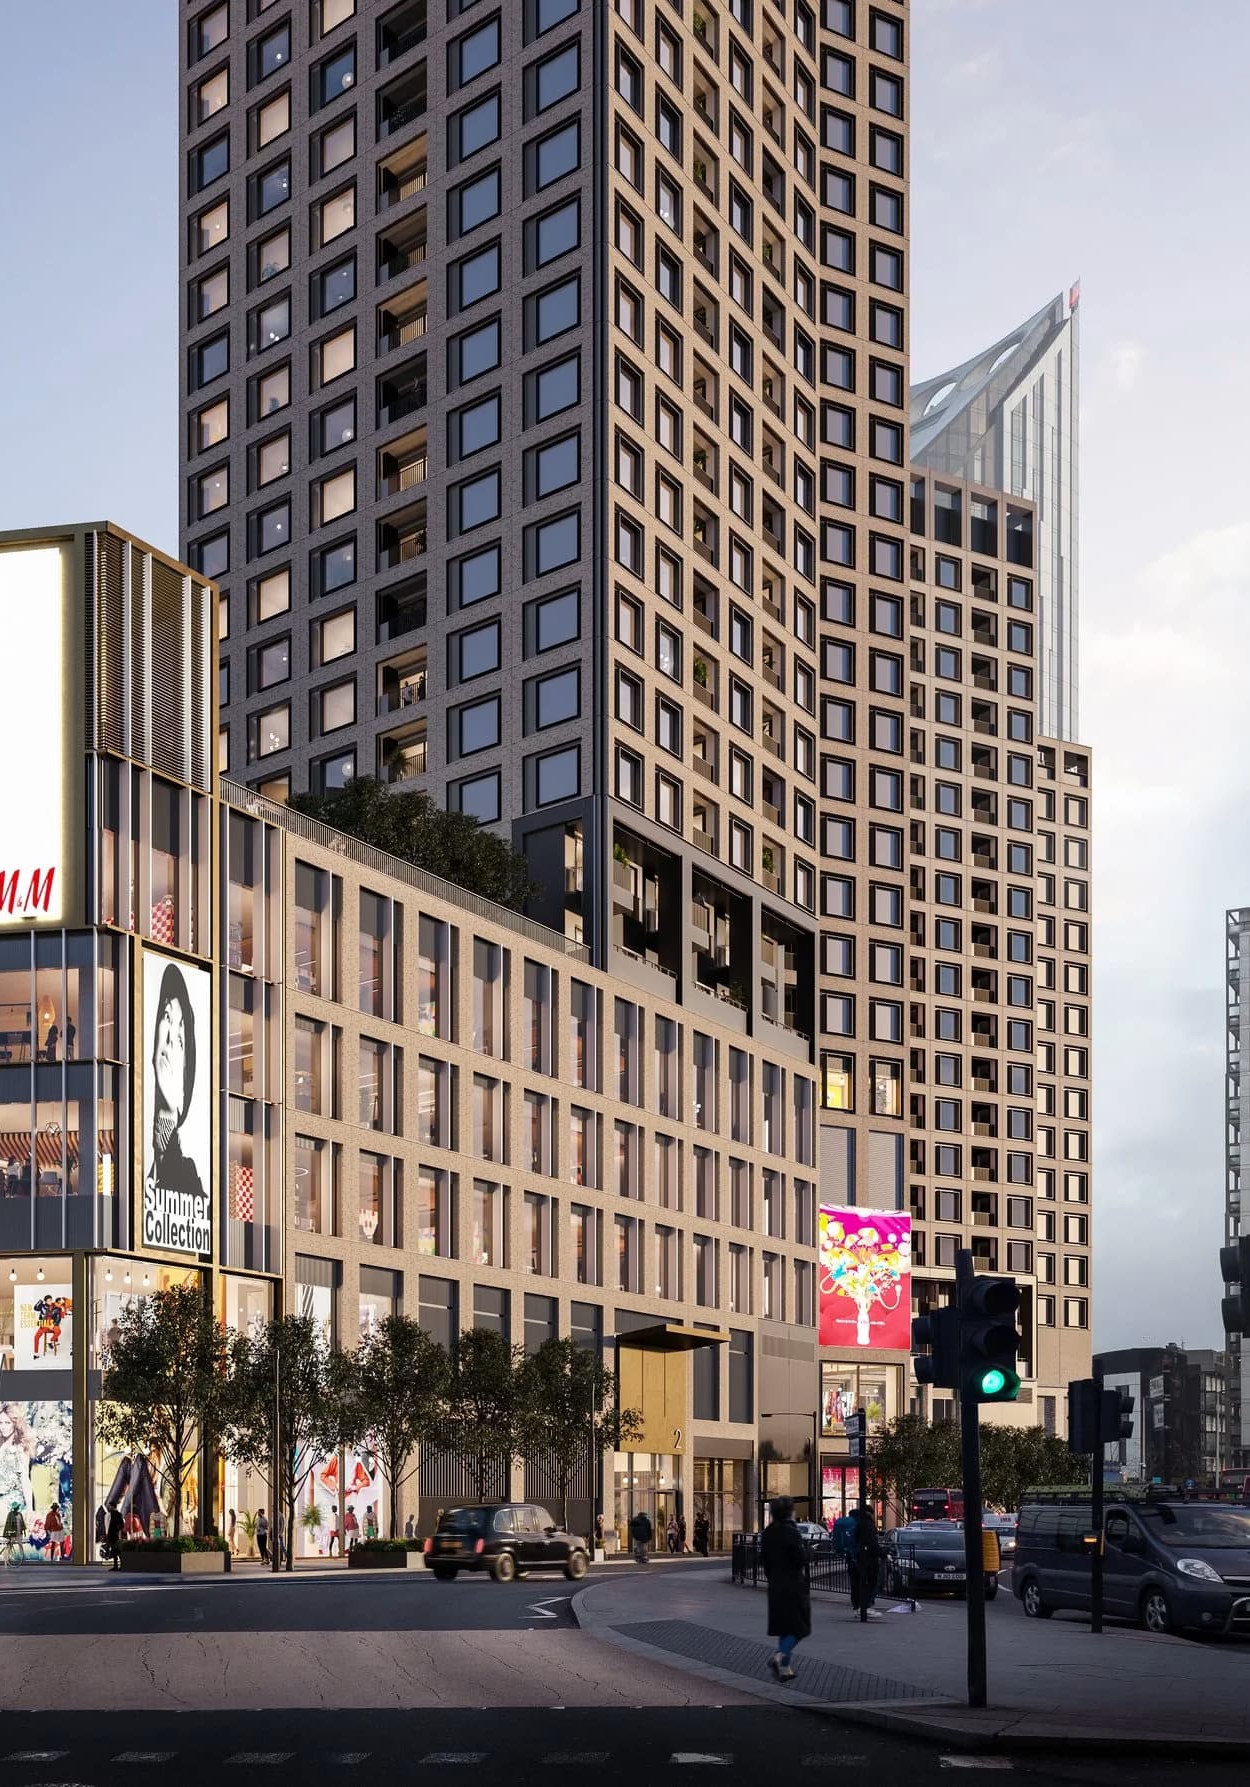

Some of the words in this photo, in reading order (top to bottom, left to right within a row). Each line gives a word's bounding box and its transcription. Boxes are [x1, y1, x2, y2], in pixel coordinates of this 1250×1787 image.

[145, 1177, 210, 1221] Summer
[146, 1210, 210, 1252] Collection
[674, 1429, 681, 1449] 2
